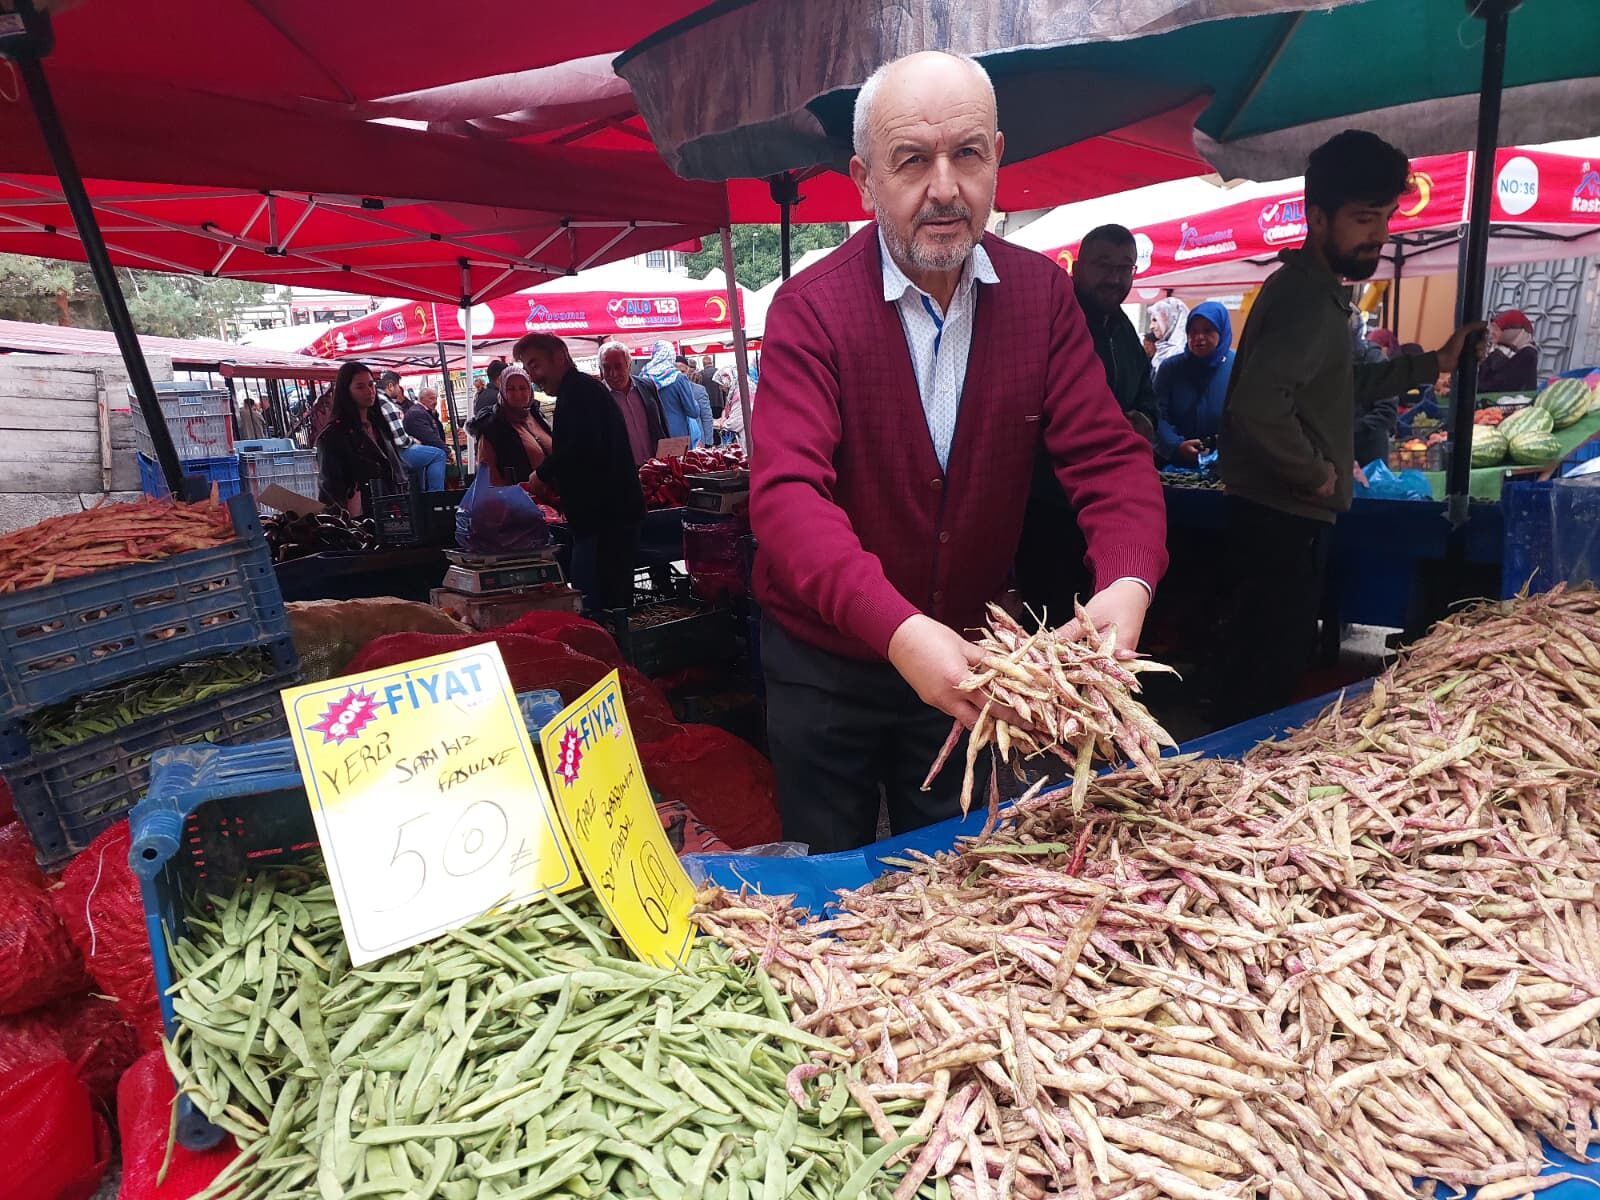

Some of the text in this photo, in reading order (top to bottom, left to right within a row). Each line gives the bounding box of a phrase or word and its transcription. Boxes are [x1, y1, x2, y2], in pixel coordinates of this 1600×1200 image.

[1500, 178, 1535, 195] NO:36
[1282, 202, 1306, 223] AL
[627, 300, 677, 314] ALO 153
[384, 663, 482, 715] FİYAT
[579, 692, 615, 751] FİYAT
[395, 748, 438, 784] SARI
[630, 840, 679, 934] 60
